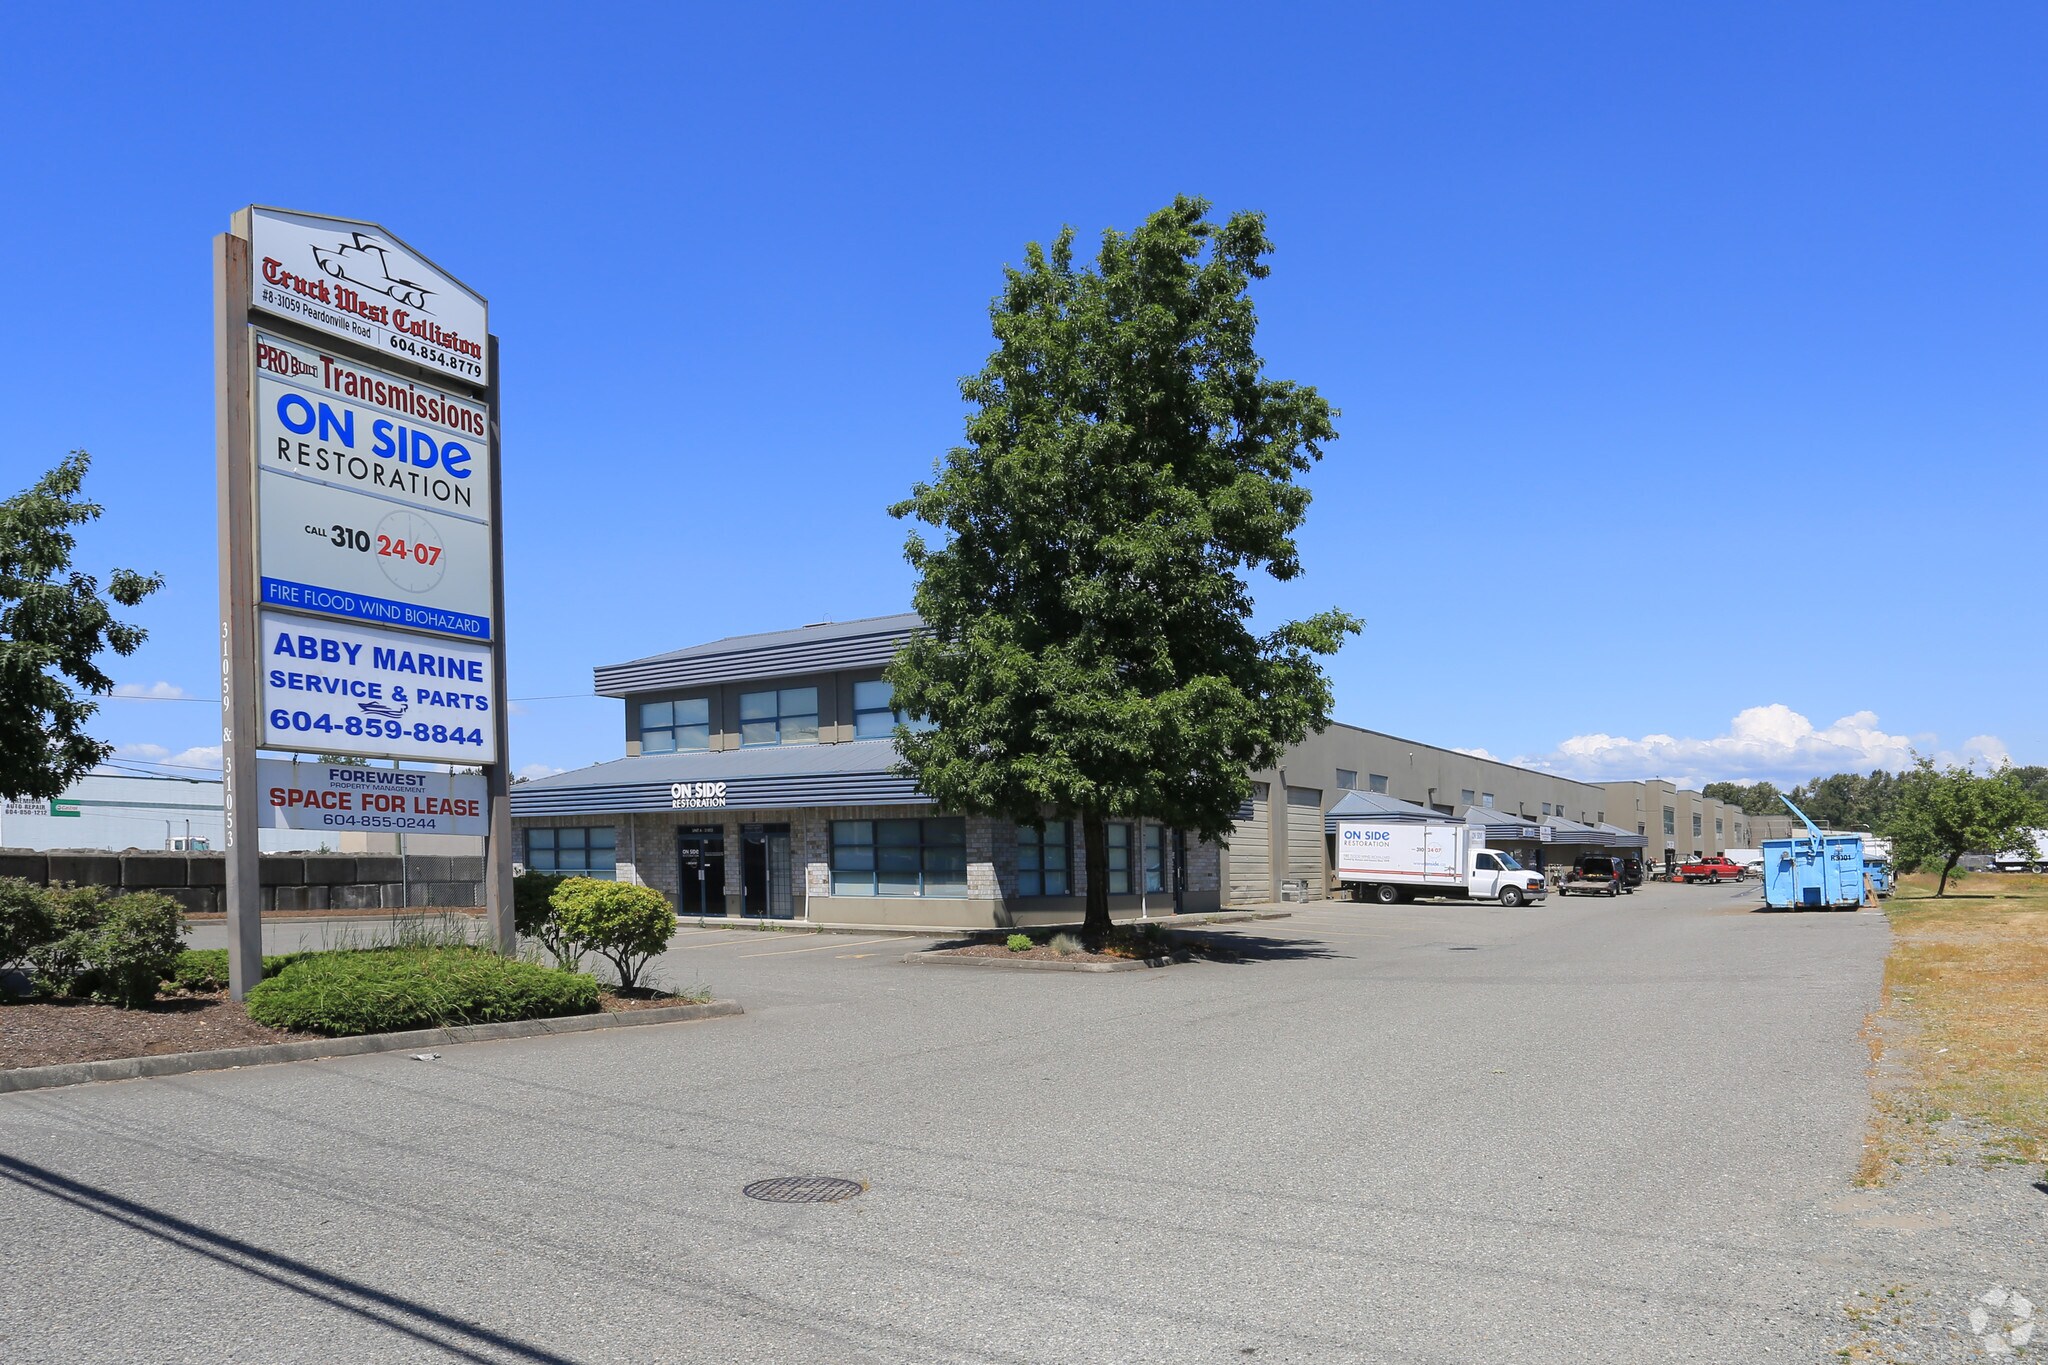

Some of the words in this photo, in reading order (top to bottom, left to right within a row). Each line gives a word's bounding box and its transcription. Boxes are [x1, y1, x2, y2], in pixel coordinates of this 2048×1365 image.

[262, 256, 331, 305] Truck
[334, 284, 388, 325] West
[392, 308, 482, 360] Collision
[262, 289, 300, 312] #8-31059
[302, 303, 350, 330] Peardonville
[352, 322, 371, 338] Road
[390, 336, 482, 378] 604.854.8779
[257, 343, 288, 375] PRO
[320, 355, 484, 436] Transmissions
[276, 393, 354, 449] ON
[278, 437, 471, 508] RESTORATION
[304, 525, 327, 538] CALL
[330, 524, 370, 552] 310
[376, 534, 442, 566] 24-07
[270, 584, 298, 602] FIRE
[304, 590, 354, 612] FLOOD
[359, 600, 400, 620] WIND
[405, 610, 480, 633] BIOHAZARD
[222, 622, 230, 712] 31059
[273, 632, 362, 666] ABBY
[374, 647, 484, 682] MARINE
[270, 670, 382, 700] SERVICE
[392, 686, 408, 702] &
[417, 689, 488, 711] PARTS
[223, 727, 232, 742] &
[270, 708, 484, 746] 604-859-8844
[330, 769, 426, 786] FOREWEST
[372, 785, 426, 793] MANAGEMENT
[671, 784, 692, 799] ON
[226, 757, 234, 848] 31053
[270, 788, 352, 810] SPACE
[362, 794, 406, 812] FOR
[414, 797, 480, 816] LEASE
[324, 814, 436, 829] 604-855-0244
[672, 798, 726, 808] RESTORATION
[1344, 830, 1360, 840] ON
